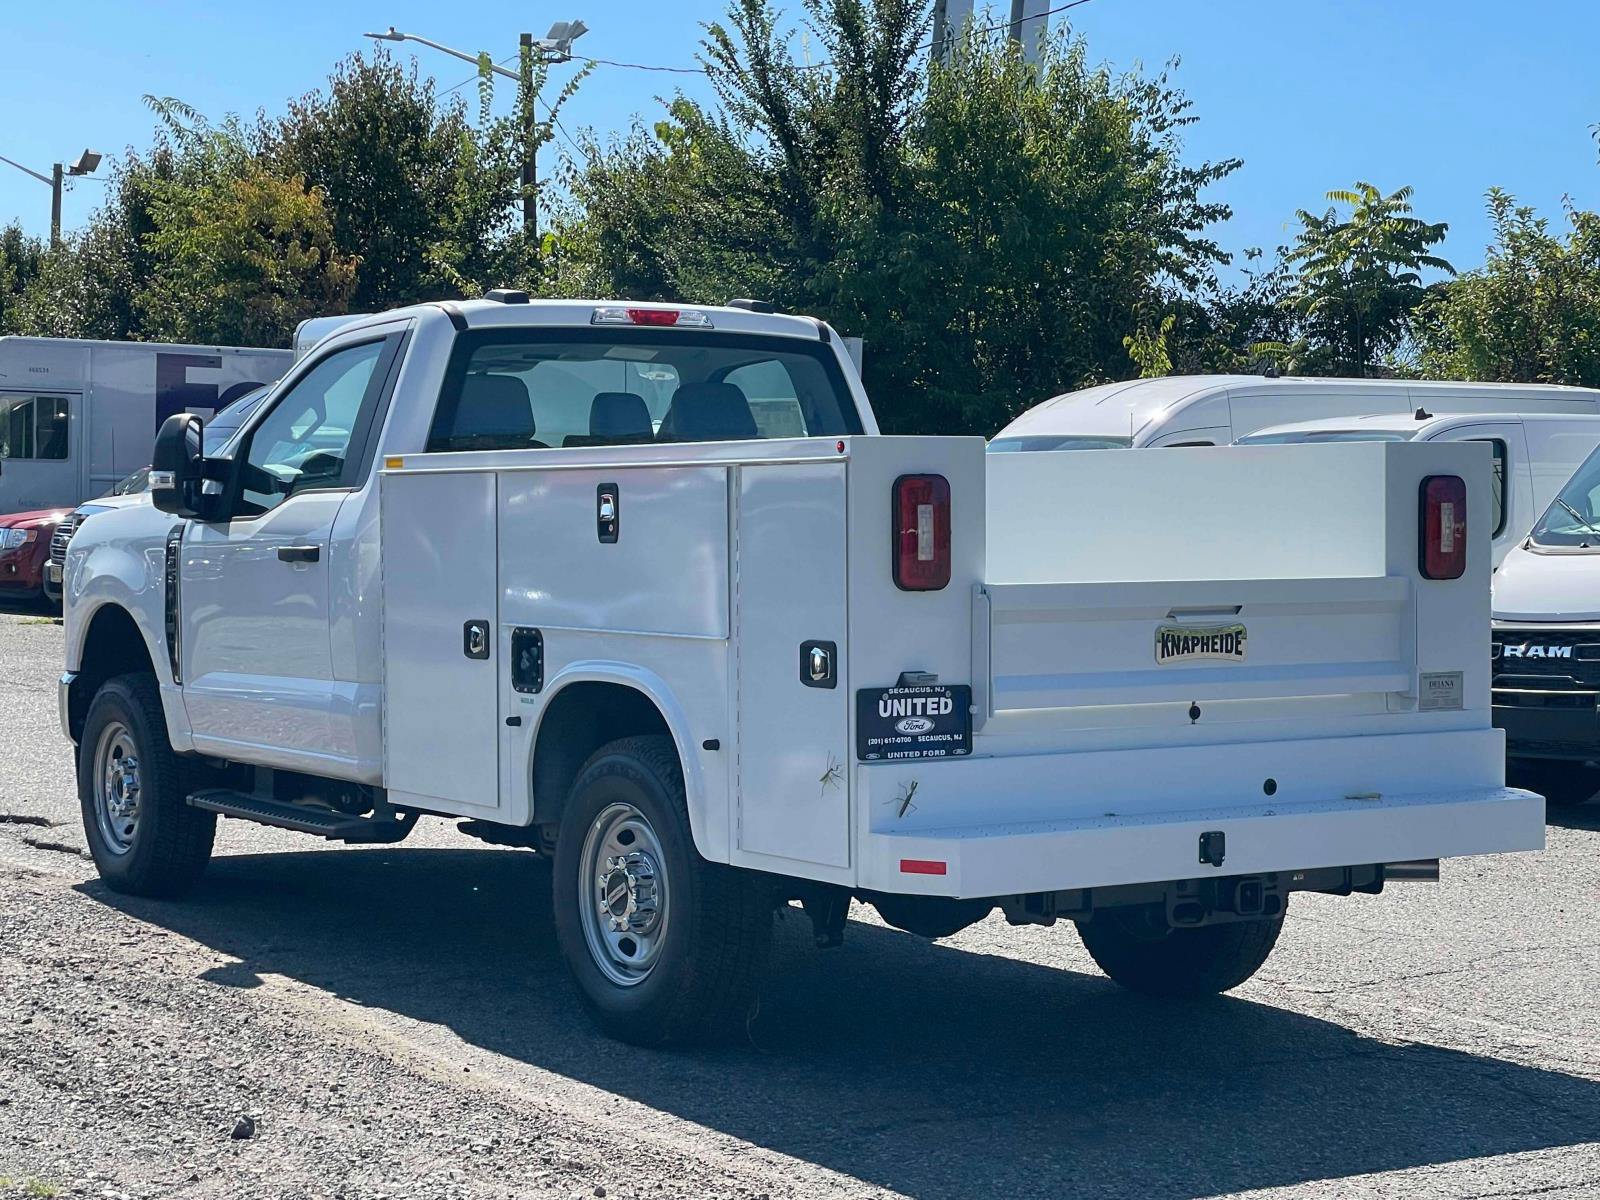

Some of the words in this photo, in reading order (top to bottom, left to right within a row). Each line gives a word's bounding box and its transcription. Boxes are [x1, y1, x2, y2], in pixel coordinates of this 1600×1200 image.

[1161, 631, 1242, 659] KNAPHEIDE
[1503, 644, 1573, 658] RAM
[879, 697, 953, 718] UNITED
[903, 720, 925, 730] Ford
[868, 737, 884, 746] (201)
[884, 736, 912, 744] 617-0700
[917, 734, 953, 742] SECAUCUS,
[887, 750, 920, 758] UNITED
